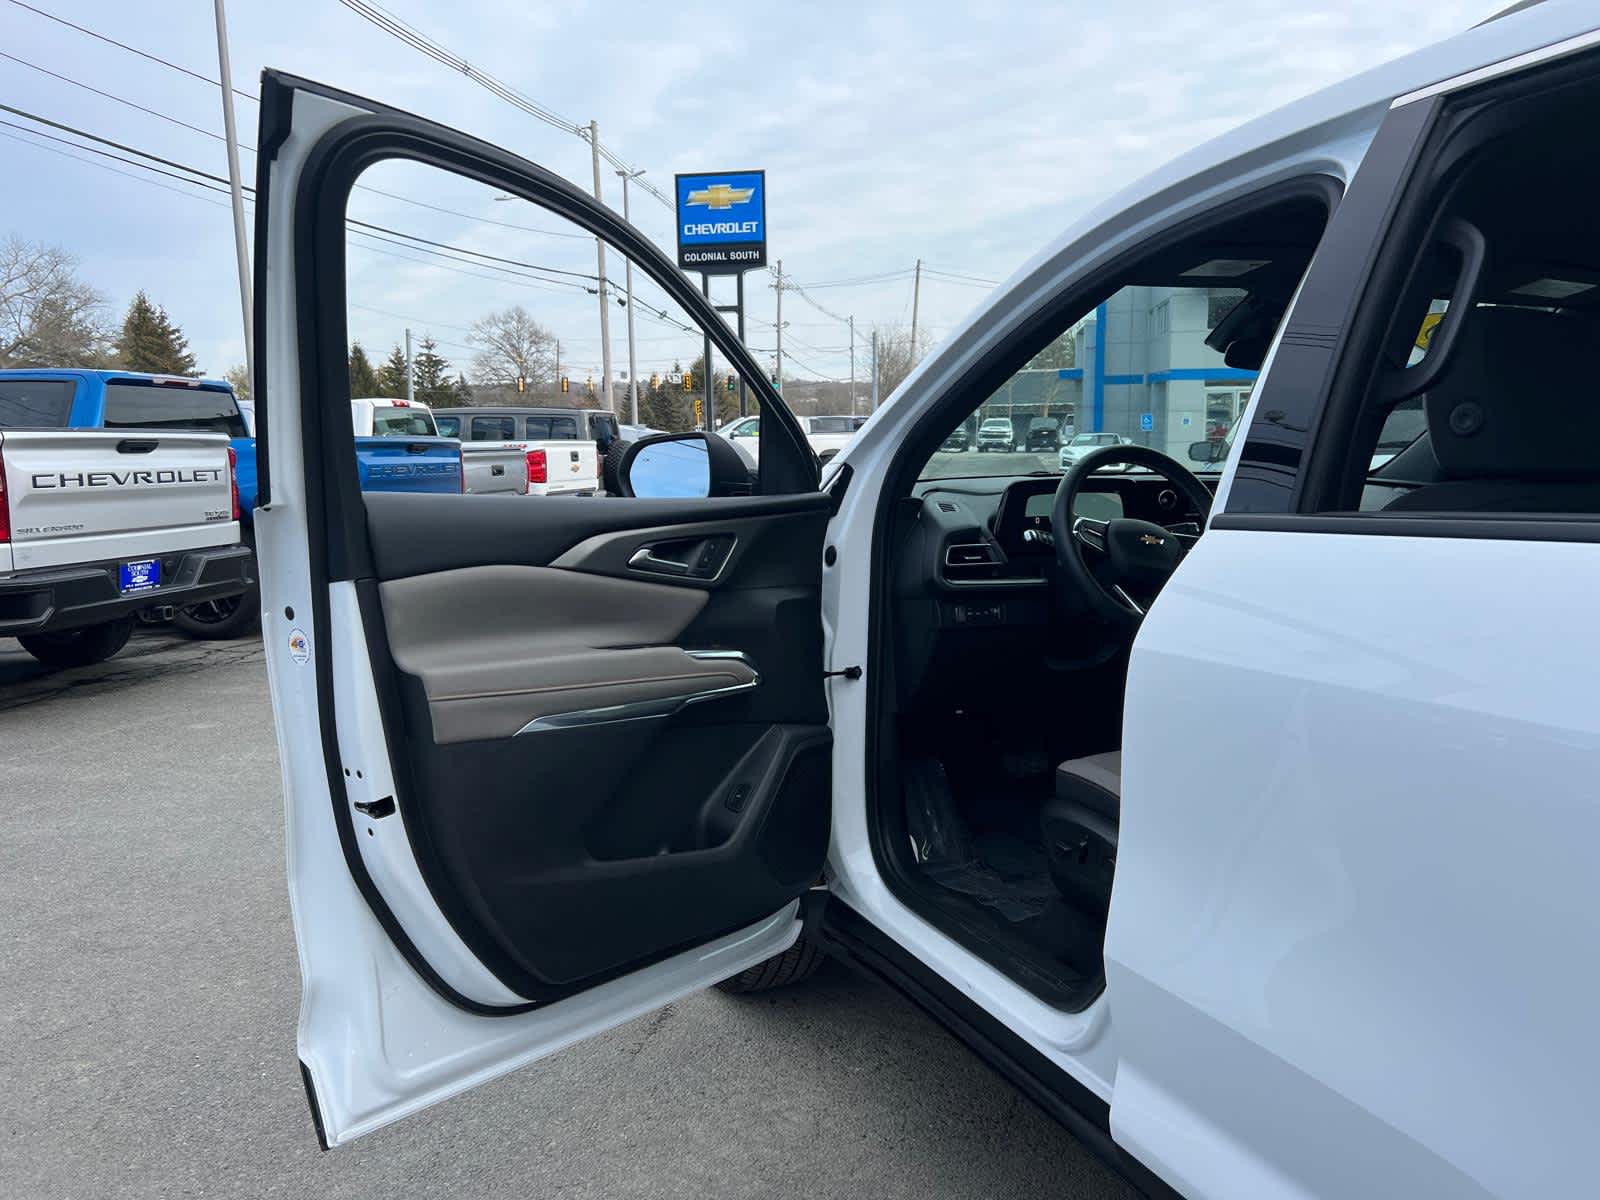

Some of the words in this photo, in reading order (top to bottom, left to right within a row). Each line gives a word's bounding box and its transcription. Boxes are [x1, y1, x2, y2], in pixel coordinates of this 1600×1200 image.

[684, 221, 758, 236] CHEVROLET
[684, 252, 727, 262] COLONIAL
[730, 250, 759, 260] SOUTH
[32, 469, 222, 489] CHEVROLET
